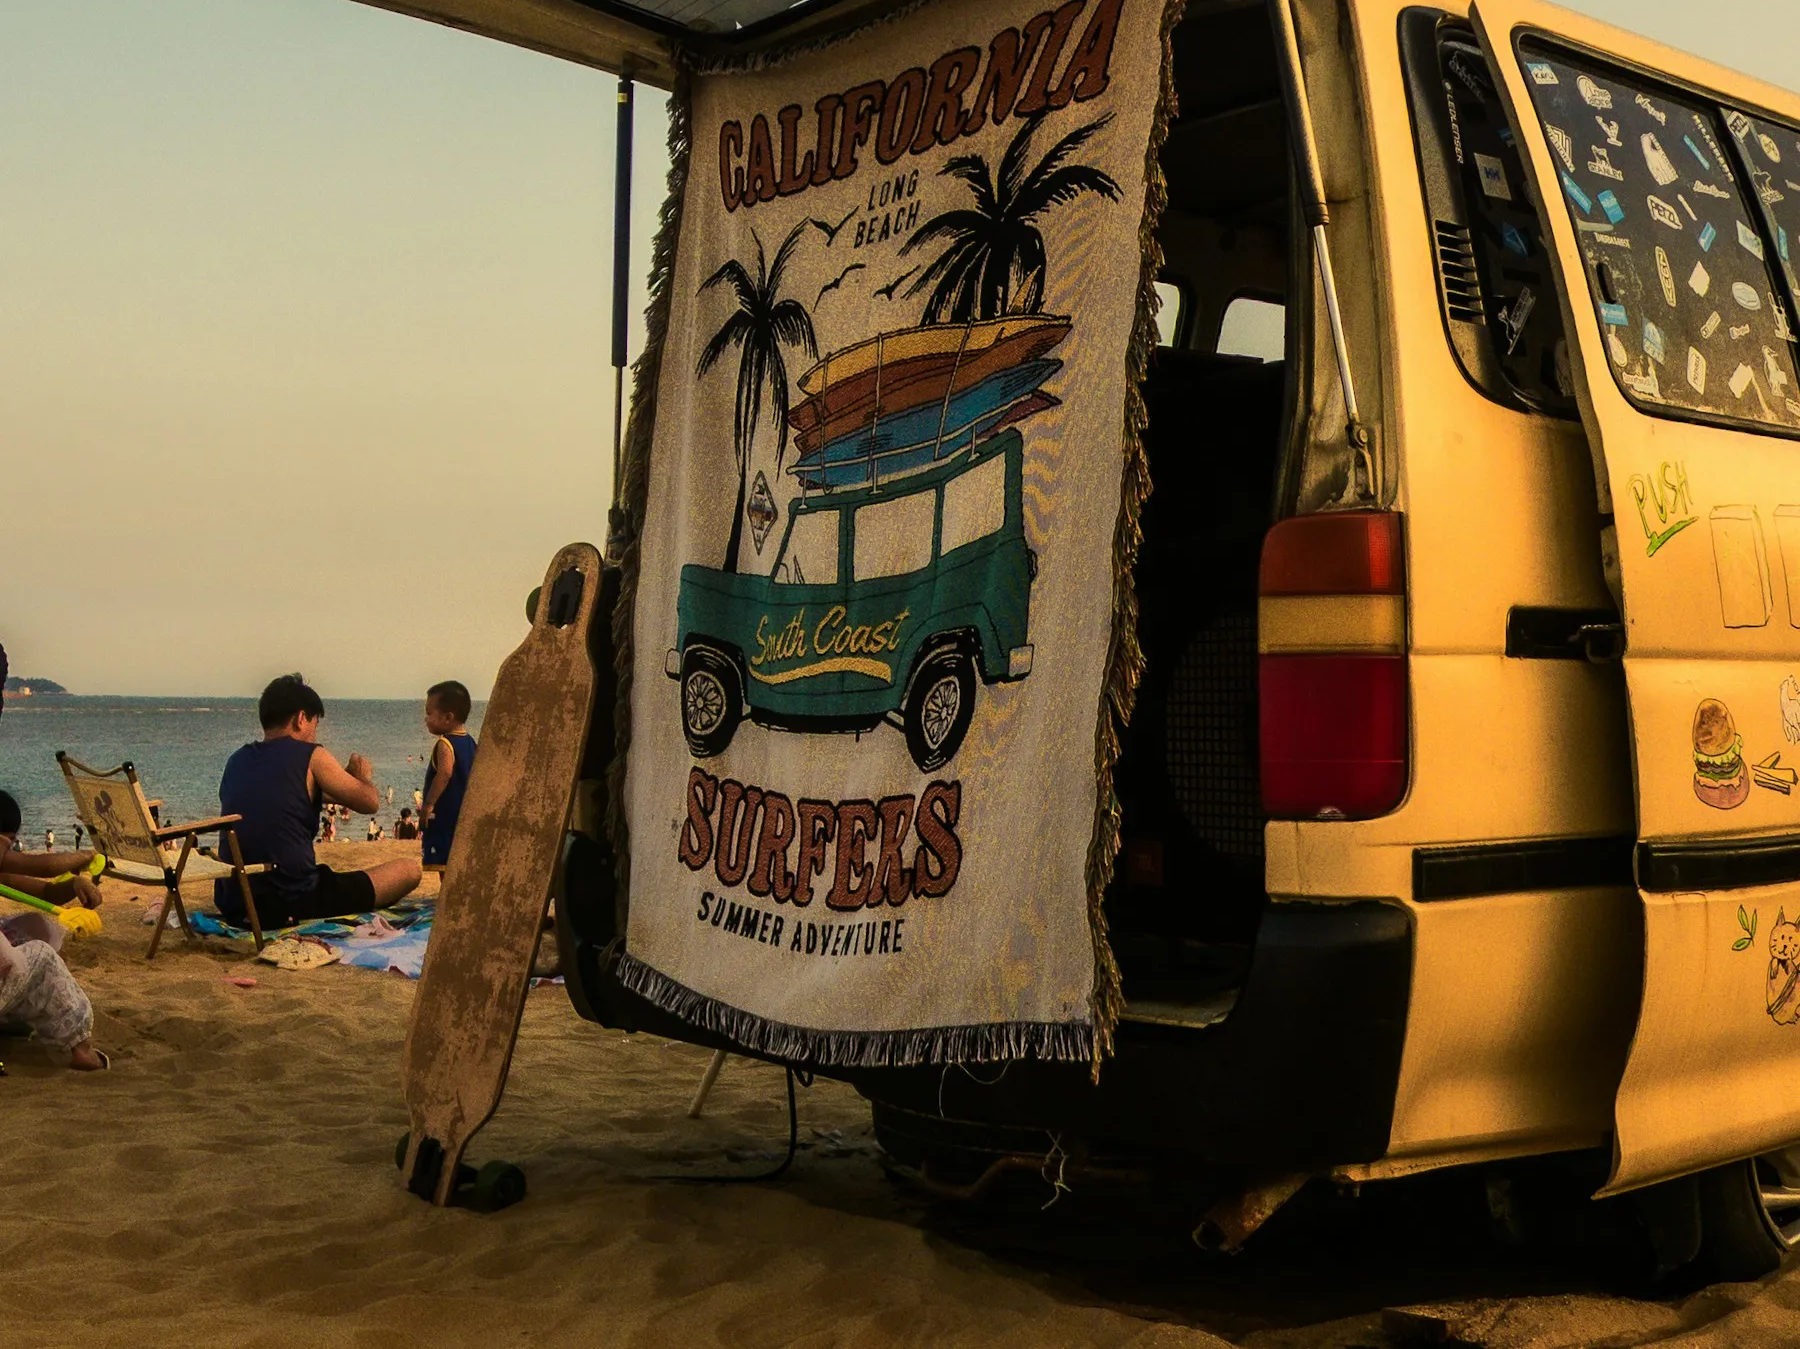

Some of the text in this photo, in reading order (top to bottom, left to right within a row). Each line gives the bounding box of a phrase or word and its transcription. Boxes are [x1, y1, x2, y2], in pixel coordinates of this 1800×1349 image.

[868, 168, 919, 212] LONG
[853, 199, 921, 249] BEACH
[1626, 460, 1695, 542] PUSH
[750, 604, 911, 667] South Coast
[678, 765, 963, 912] SURFERS
[697, 891, 906, 957] SUMMER ADVENTURE
